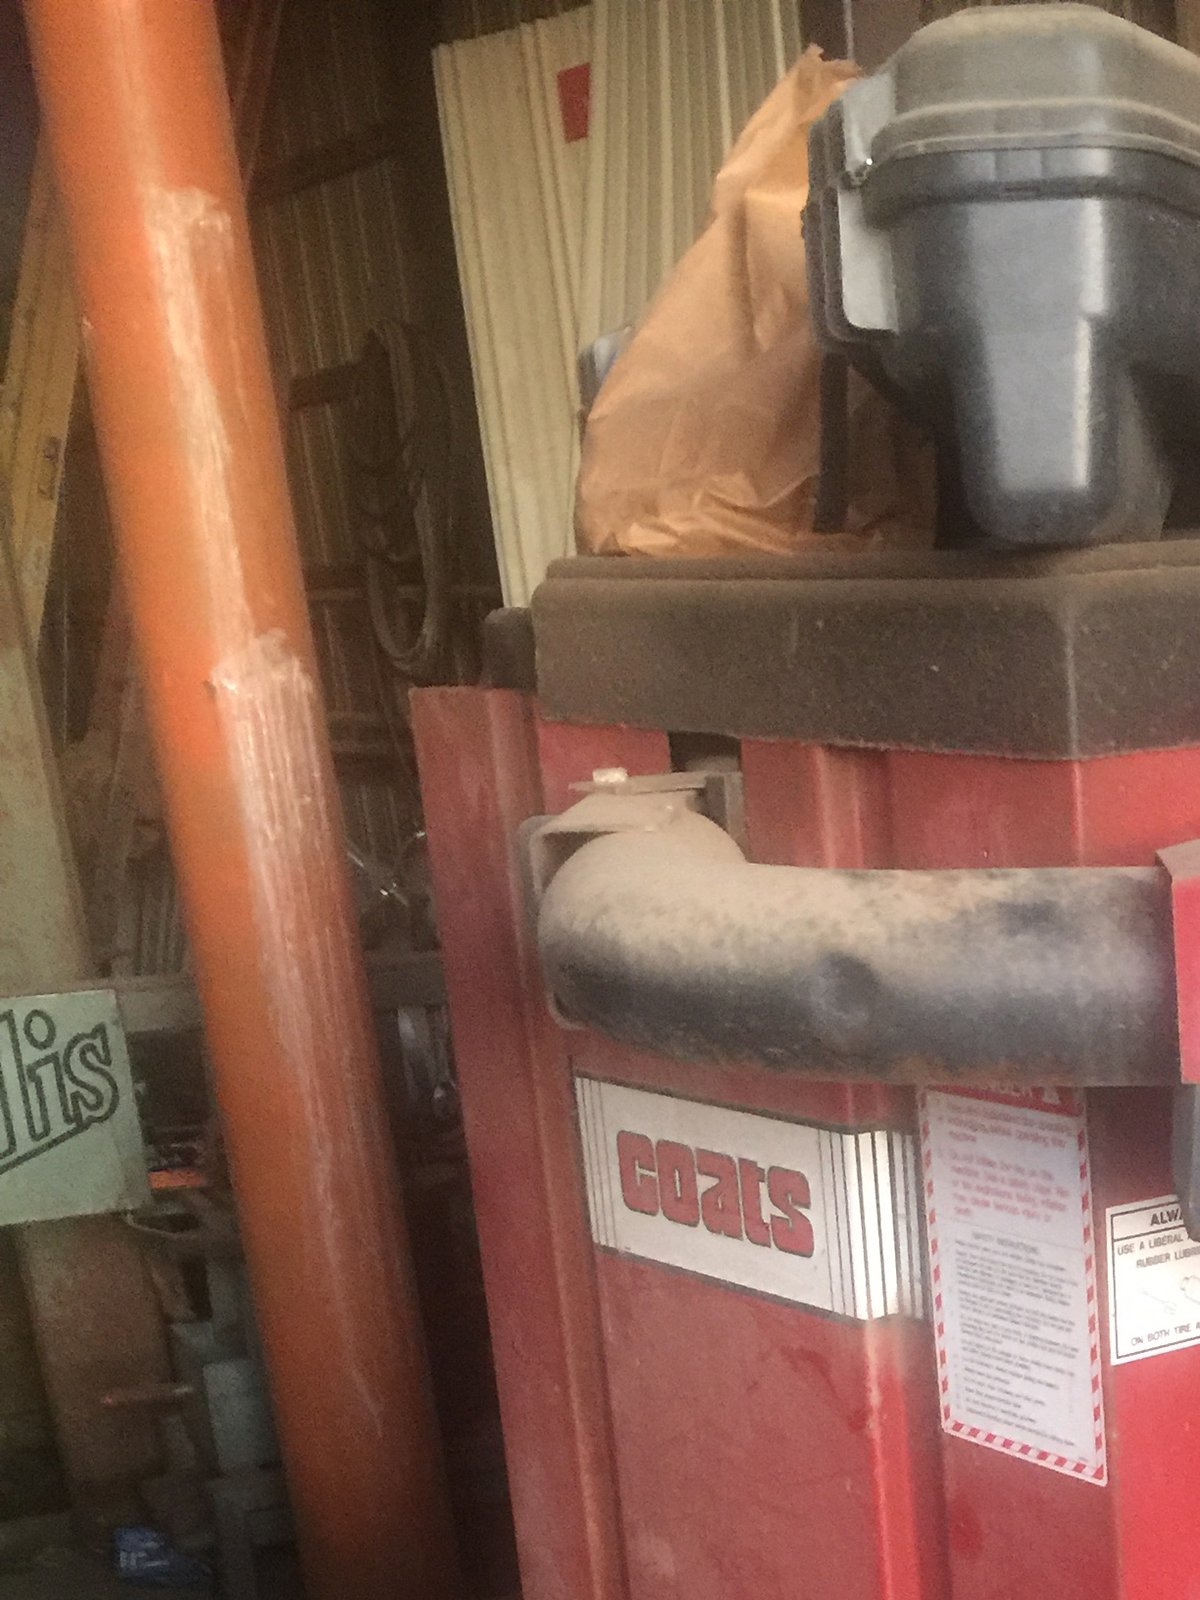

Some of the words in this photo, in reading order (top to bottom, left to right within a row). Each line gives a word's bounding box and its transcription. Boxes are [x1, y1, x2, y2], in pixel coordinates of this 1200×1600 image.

[1118, 1243, 1135, 1256] USE
[1139, 1241, 1145, 1251] A
[1149, 1233, 1184, 1249] LIBERAL
[1136, 1253, 1171, 1268] RUBBER
[1131, 1336, 1144, 1347] ON
[1147, 1329, 1170, 1343] BOTH
[1174, 1324, 1192, 1335] TIRE
